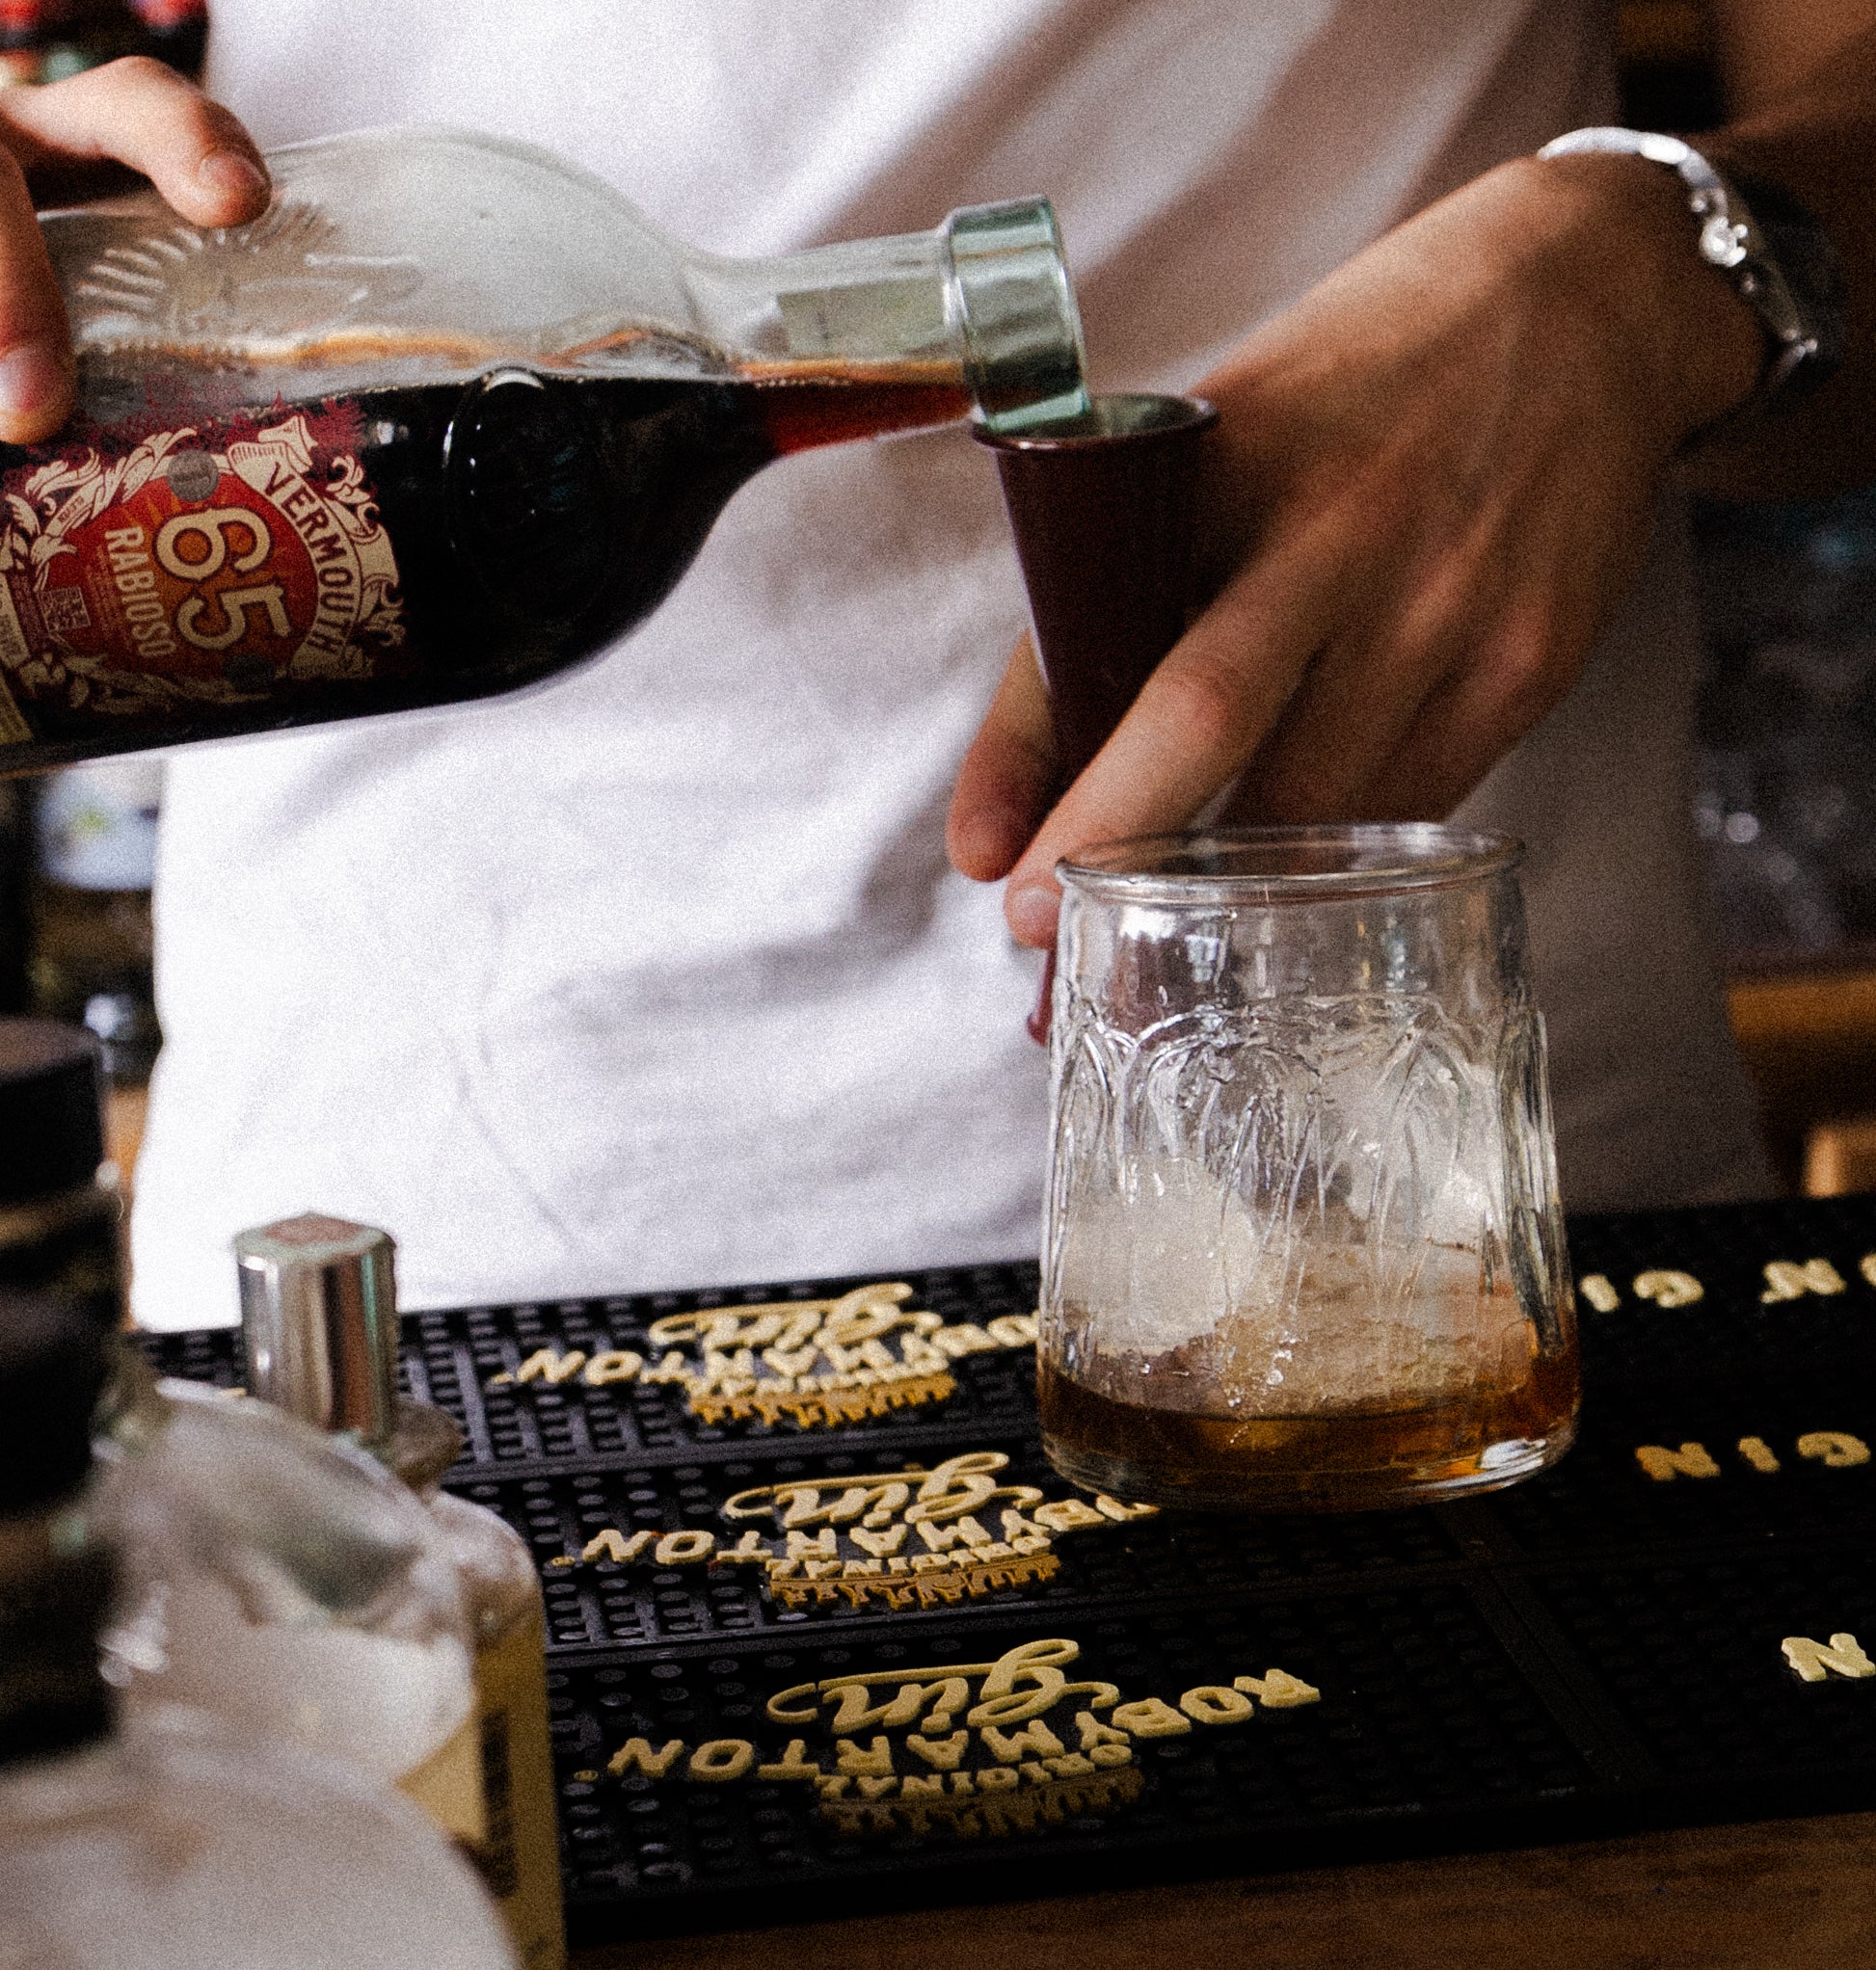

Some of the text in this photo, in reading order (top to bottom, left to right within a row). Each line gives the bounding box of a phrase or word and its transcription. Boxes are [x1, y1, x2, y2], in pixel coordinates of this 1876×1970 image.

[104, 525, 177, 658] RABIOSO
[156, 506, 288, 651] 65
[263, 463, 359, 655] VERMOUTH
[1579, 1269, 1704, 1314] GI
[516, 1310, 1040, 1386] OBYMARTON
[1635, 1430, 1872, 1481] GIN
[581, 1495, 1161, 1565] BYMARTON
[766, 1534, 1053, 1581] ORIGINAL
[814, 1744, 1134, 1800] ORIGINAL
